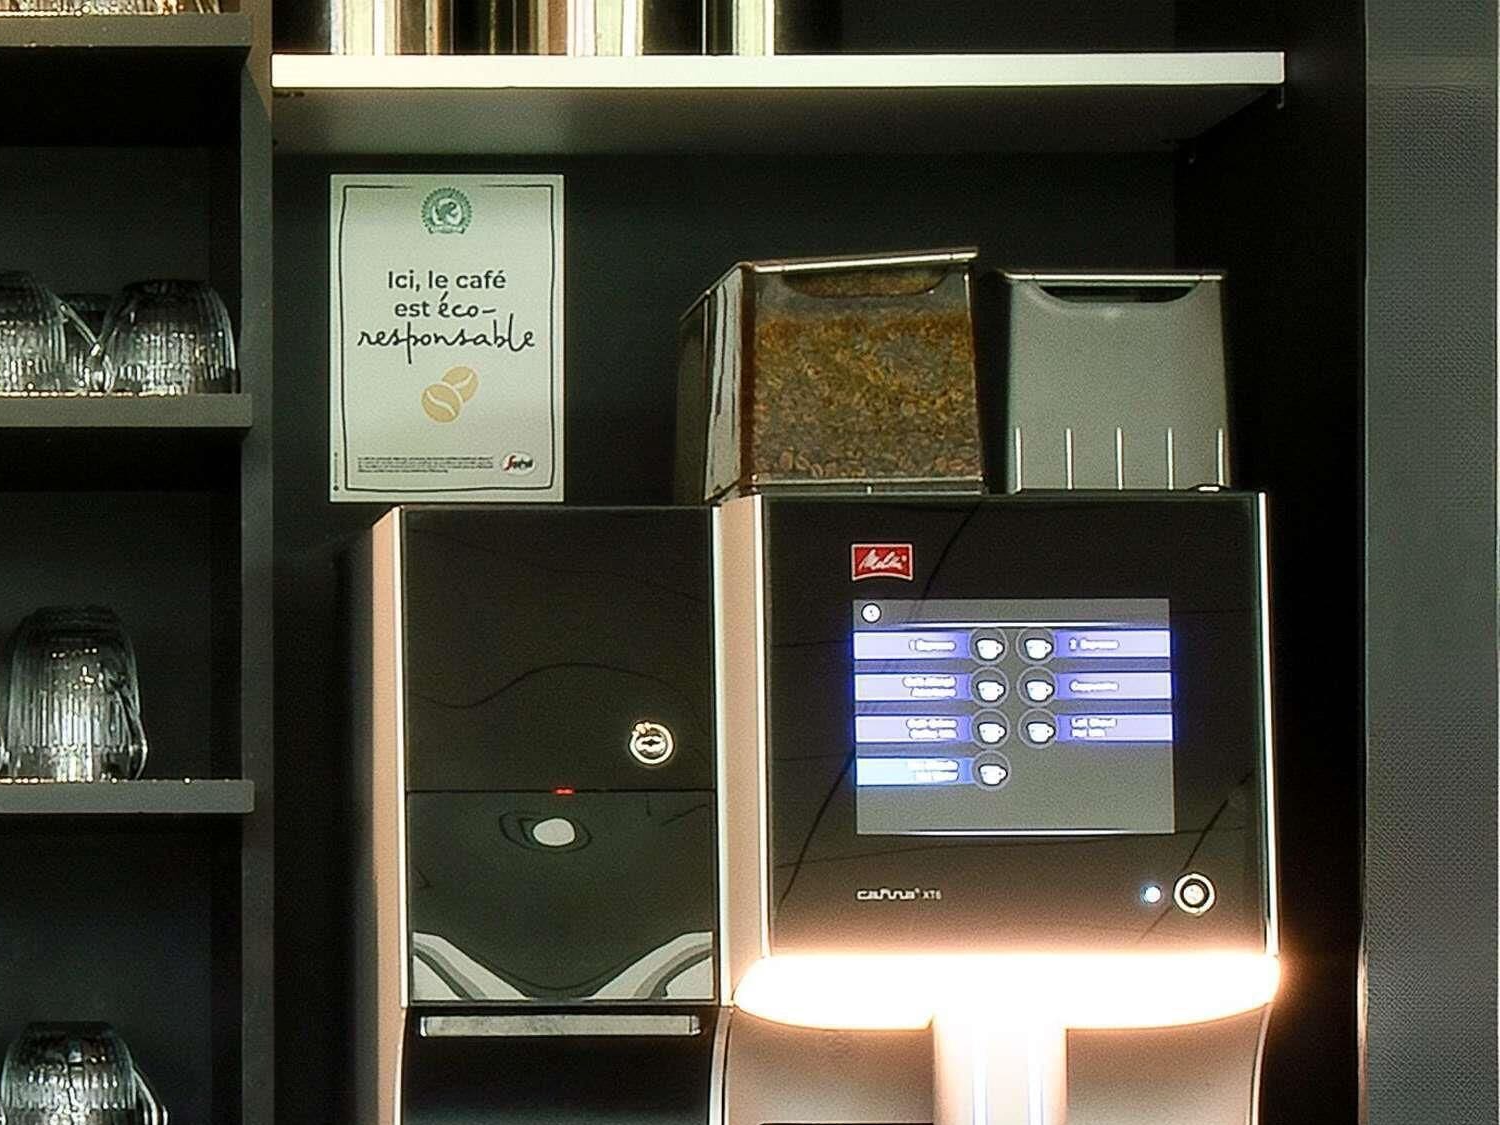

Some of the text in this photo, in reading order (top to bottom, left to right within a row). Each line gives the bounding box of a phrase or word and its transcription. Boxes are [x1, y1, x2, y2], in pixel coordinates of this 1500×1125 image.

[388, 270, 506, 292] Ici, le café
[394, 291, 497, 318] est éco-
[357, 313, 535, 364] responsable
